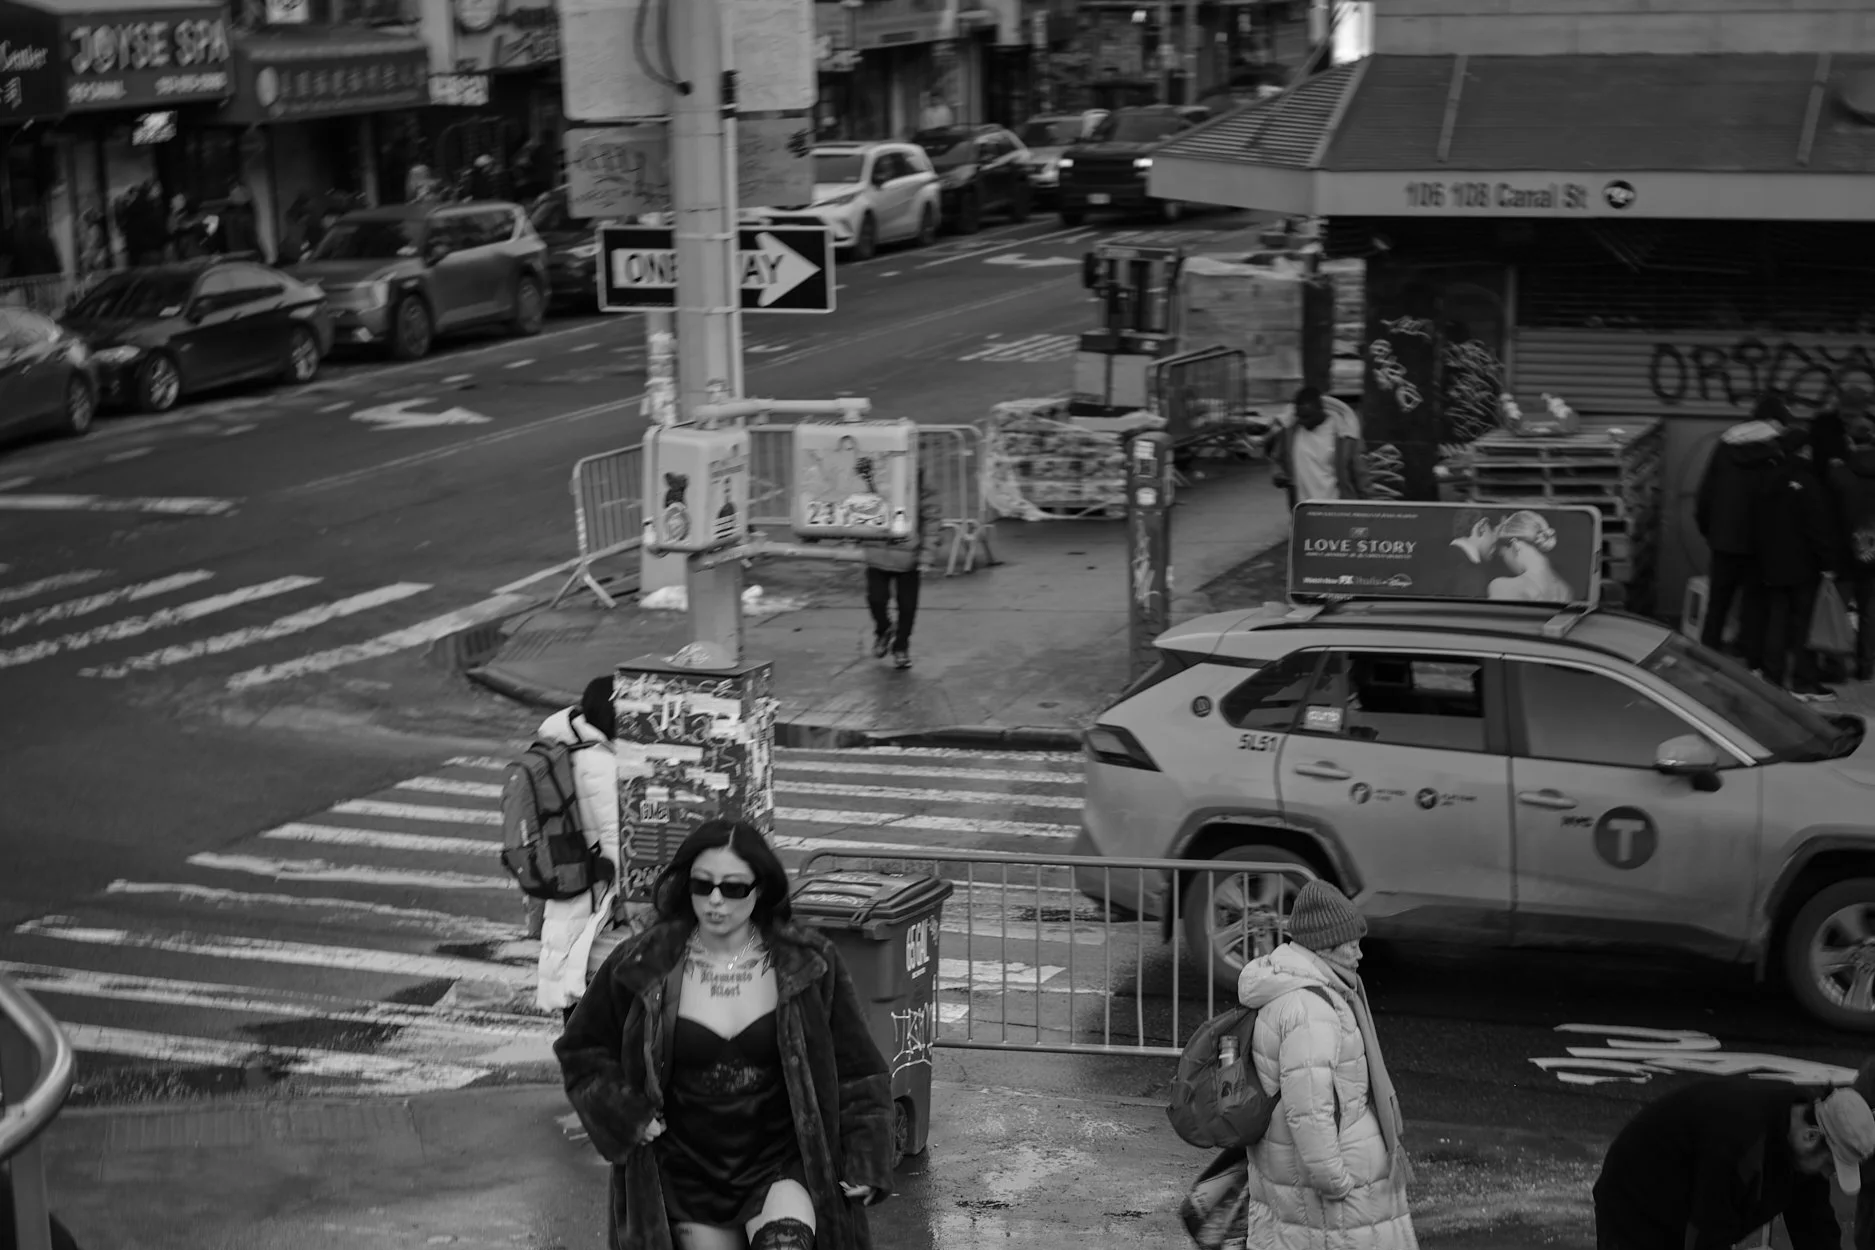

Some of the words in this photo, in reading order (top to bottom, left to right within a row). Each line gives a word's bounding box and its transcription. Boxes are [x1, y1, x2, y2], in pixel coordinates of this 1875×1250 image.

[71, 20, 170, 75] JOYSE
[174, 17, 230, 67] SPA
[1495, 182, 1559, 209] Canal
[1562, 182, 1589, 209] St
[1304, 540, 1351, 552] LOVE
[1356, 540, 1416, 554] STORY
[1607, 818, 1646, 863] T
